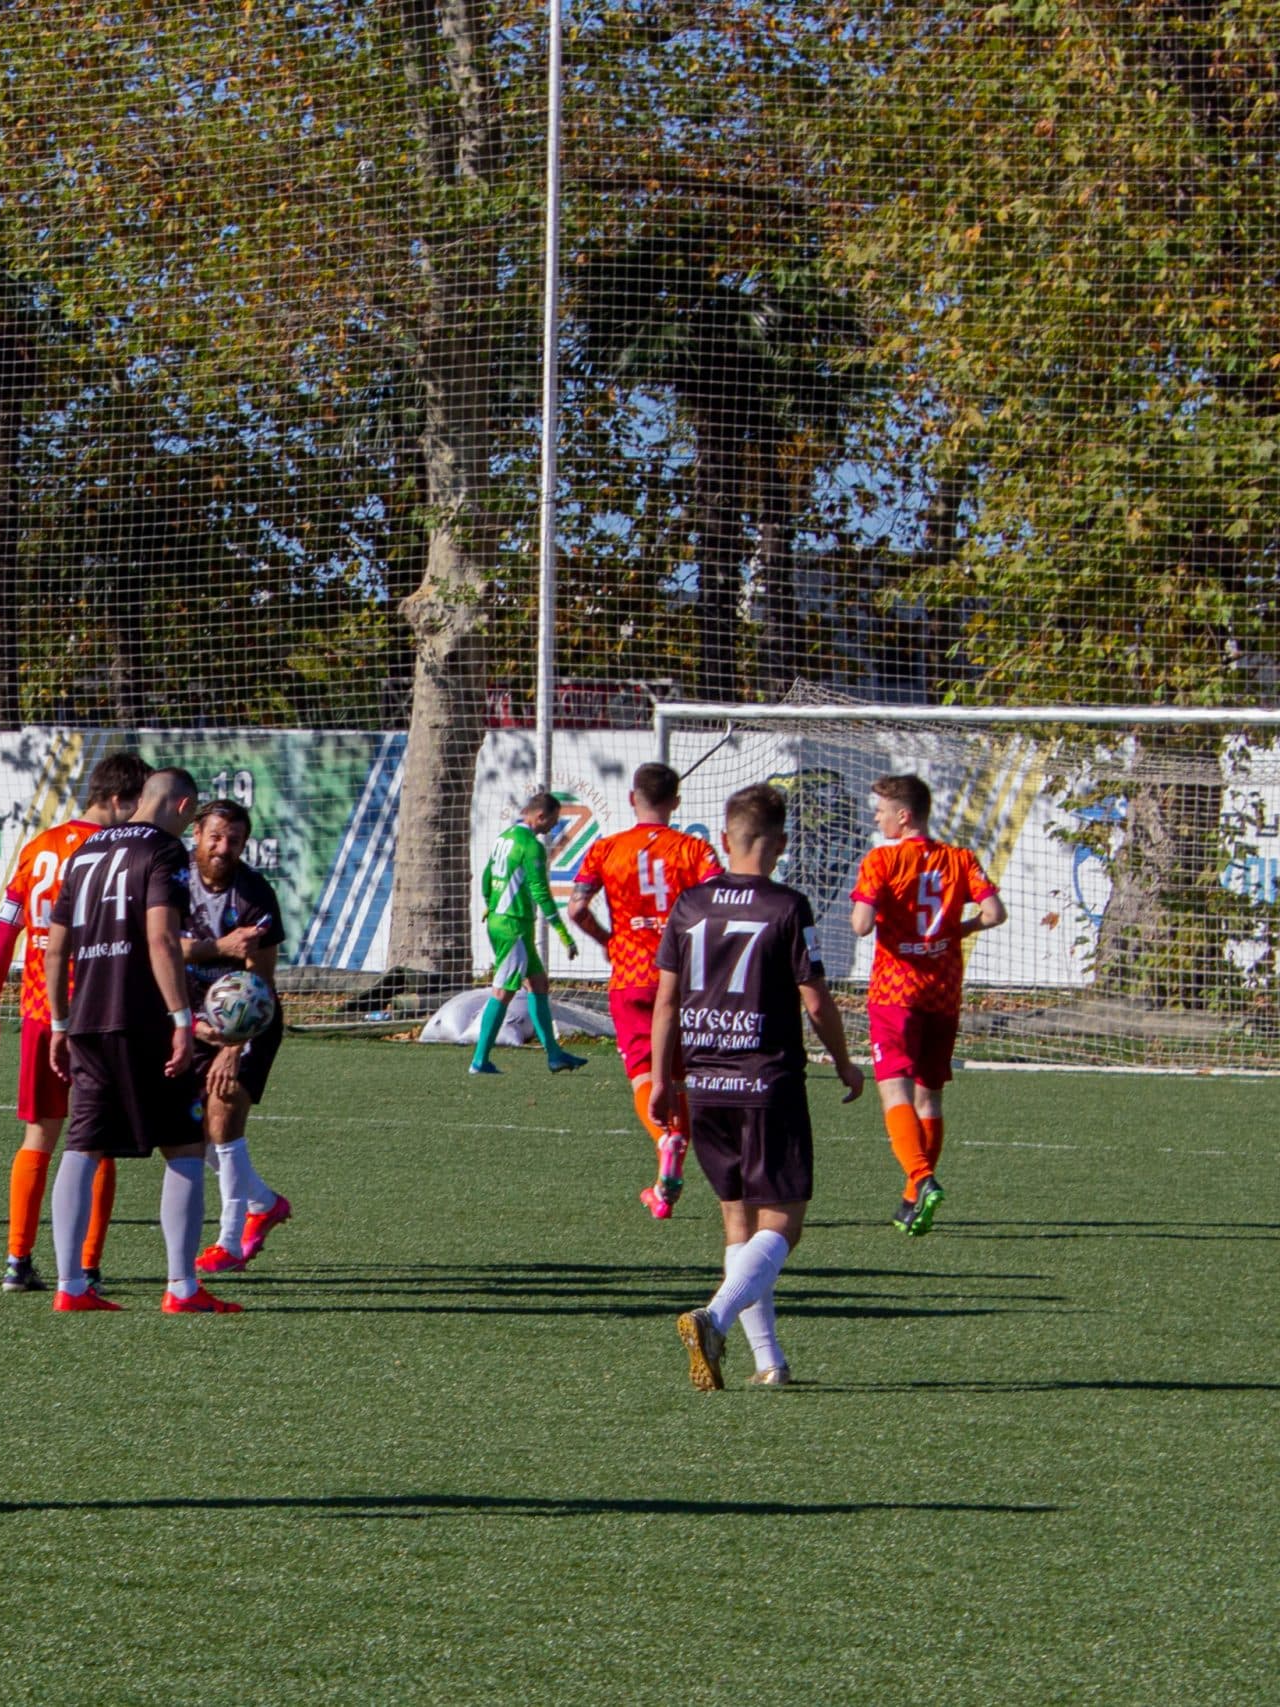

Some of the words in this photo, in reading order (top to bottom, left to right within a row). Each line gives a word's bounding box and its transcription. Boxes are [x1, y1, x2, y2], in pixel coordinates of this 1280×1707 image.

[71, 847, 132, 927] 74
[637, 849, 671, 912] 4
[712, 888, 755, 905] КИМ
[917, 870, 943, 936] 5
[685, 918, 769, 993] 17
